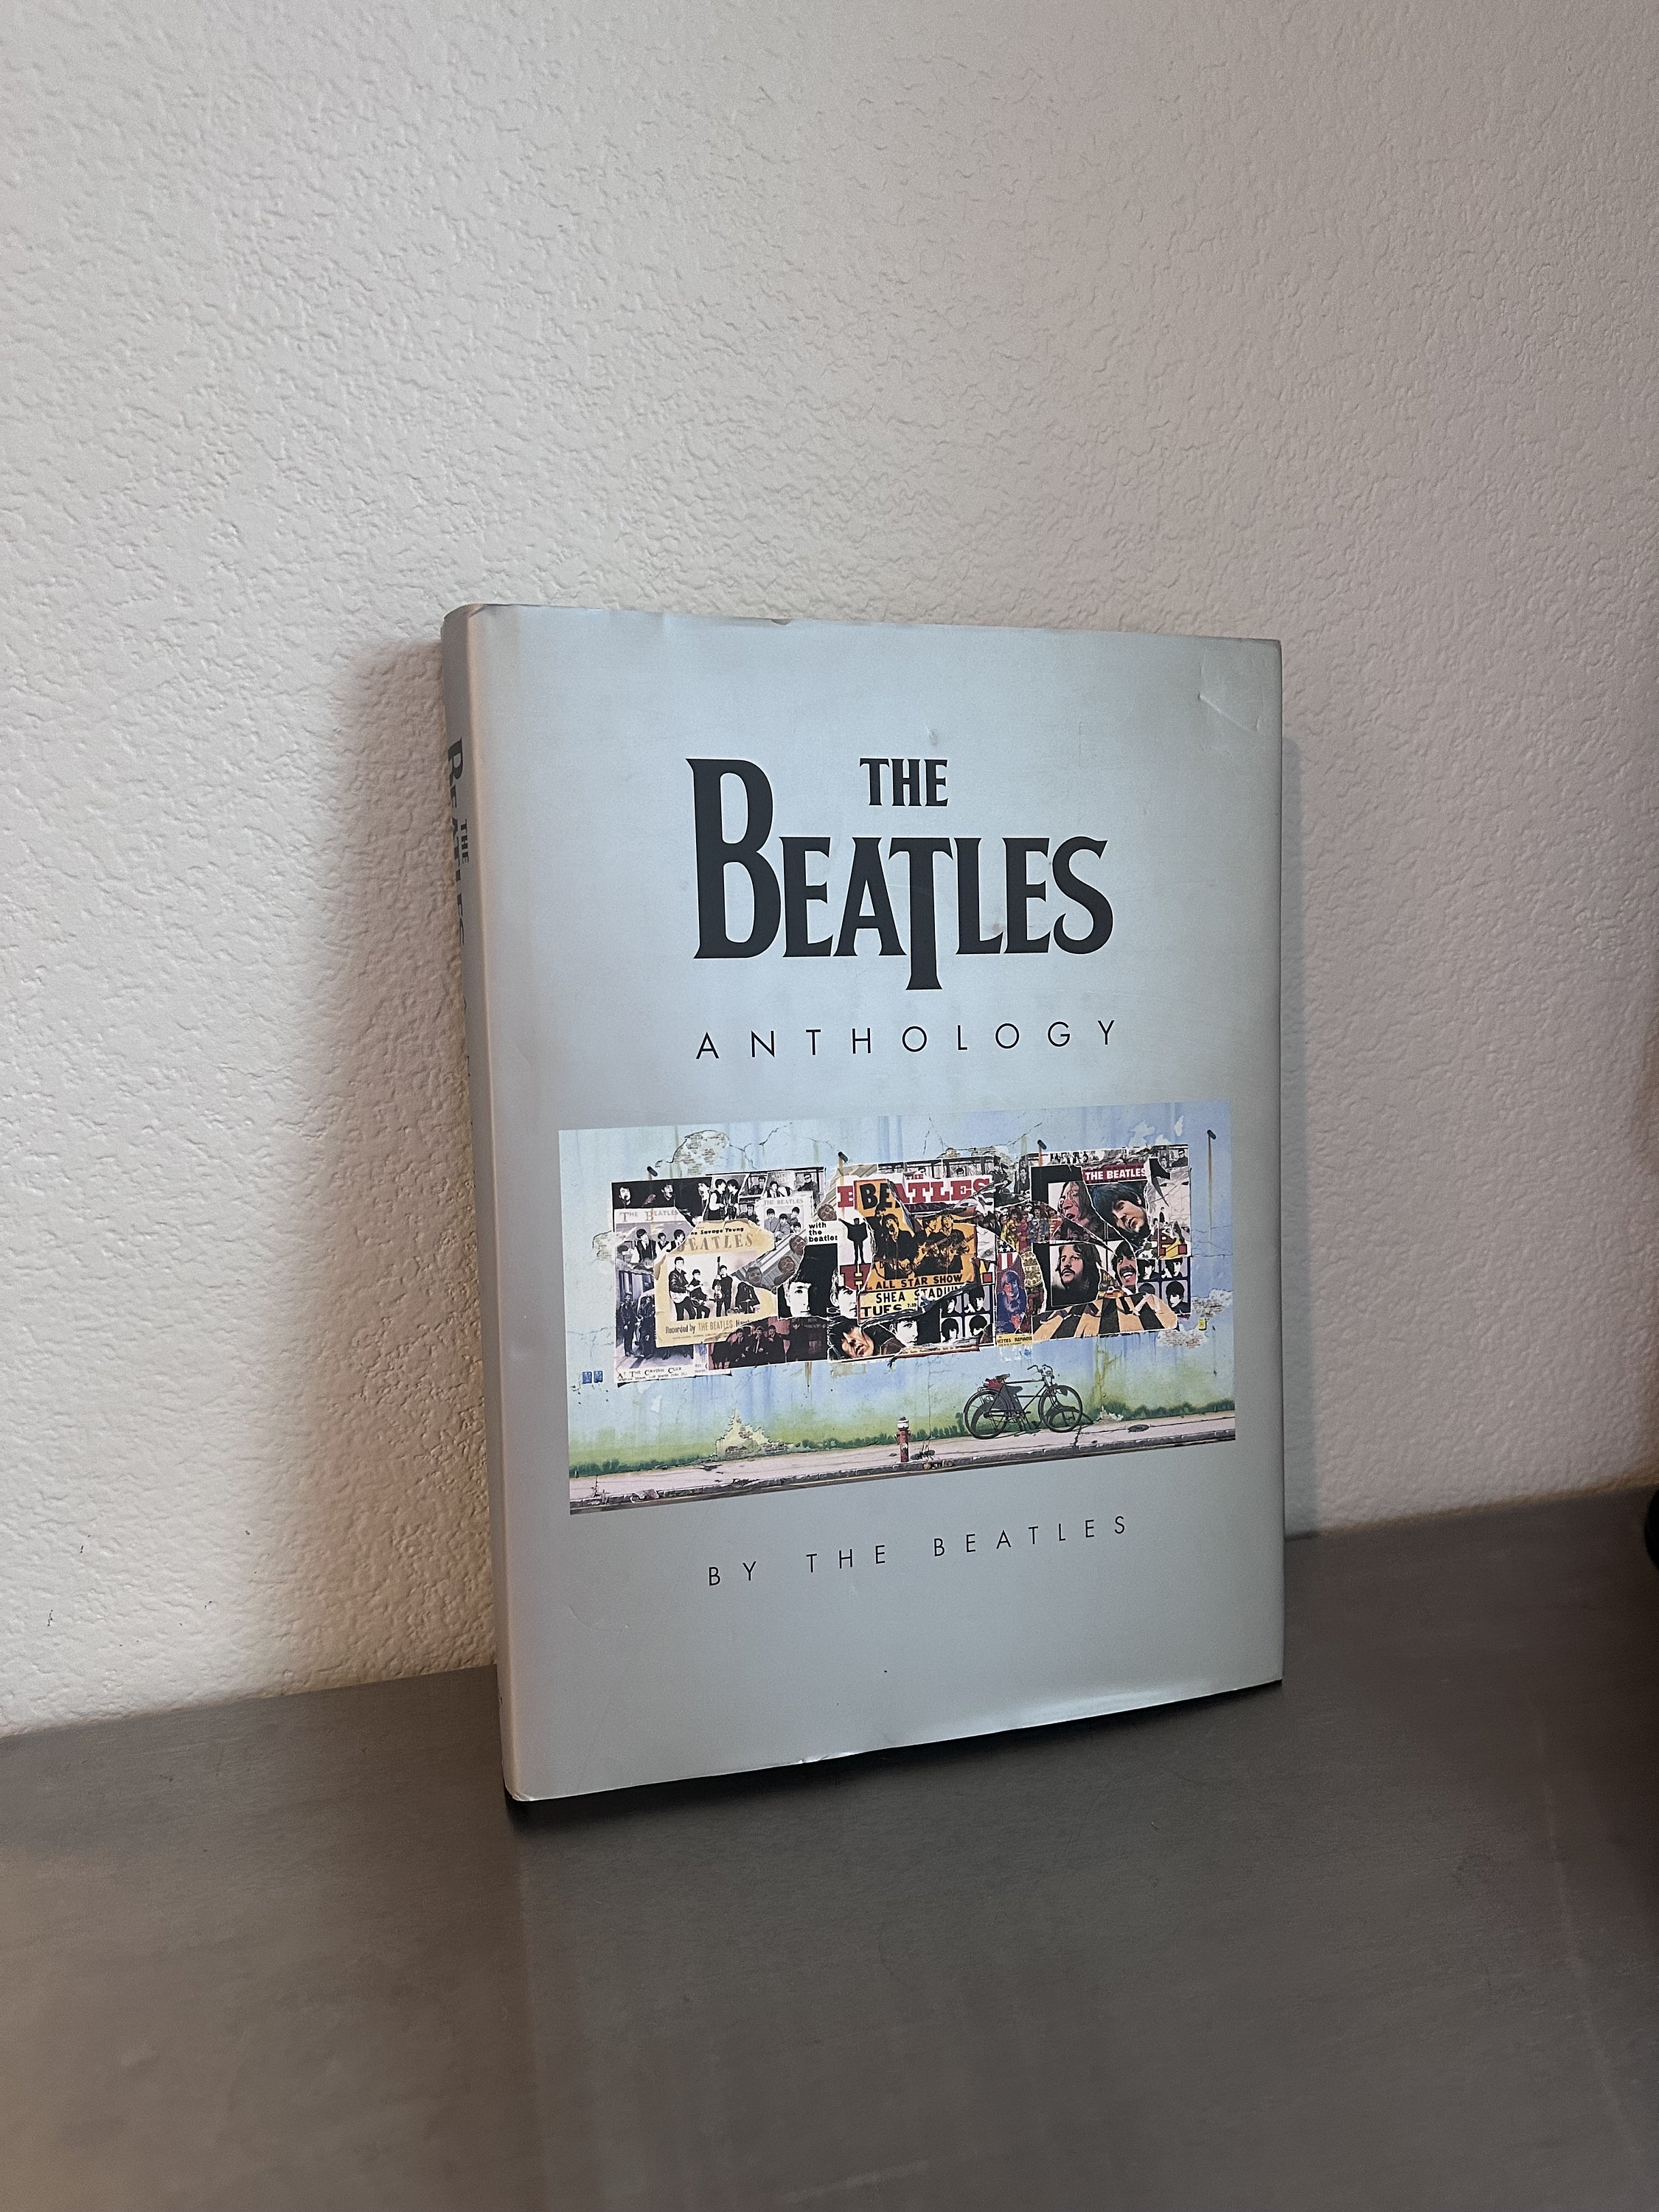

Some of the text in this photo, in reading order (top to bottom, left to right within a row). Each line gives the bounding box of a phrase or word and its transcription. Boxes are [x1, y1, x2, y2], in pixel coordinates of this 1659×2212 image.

[860, 757, 949, 807] THE
[686, 758, 1113, 990] BEATLES
[696, 1020, 1115, 1060] ANTHOLOGY
[1085, 1168, 1146, 1180] THE BEATLES
[619, 1209, 678, 1222] THE BEATLES
[700, 1228, 723, 1236] Savage
[809, 1221, 827, 1229] with
[875, 1273, 964, 1290] ALL STAR SHOW
[876, 1291, 906, 1304] SHEA
[665, 1324, 689, 1335] Recorded
[689, 1324, 696, 1334] by
[698, 1322, 709, 1332] THE
[710, 1320, 733, 1330] BEATLES
[629, 1370, 641, 1378] THE
[644, 1368, 665, 1377] CAVERN
[708, 1515, 1126, 1587] BY THE BEATLES
